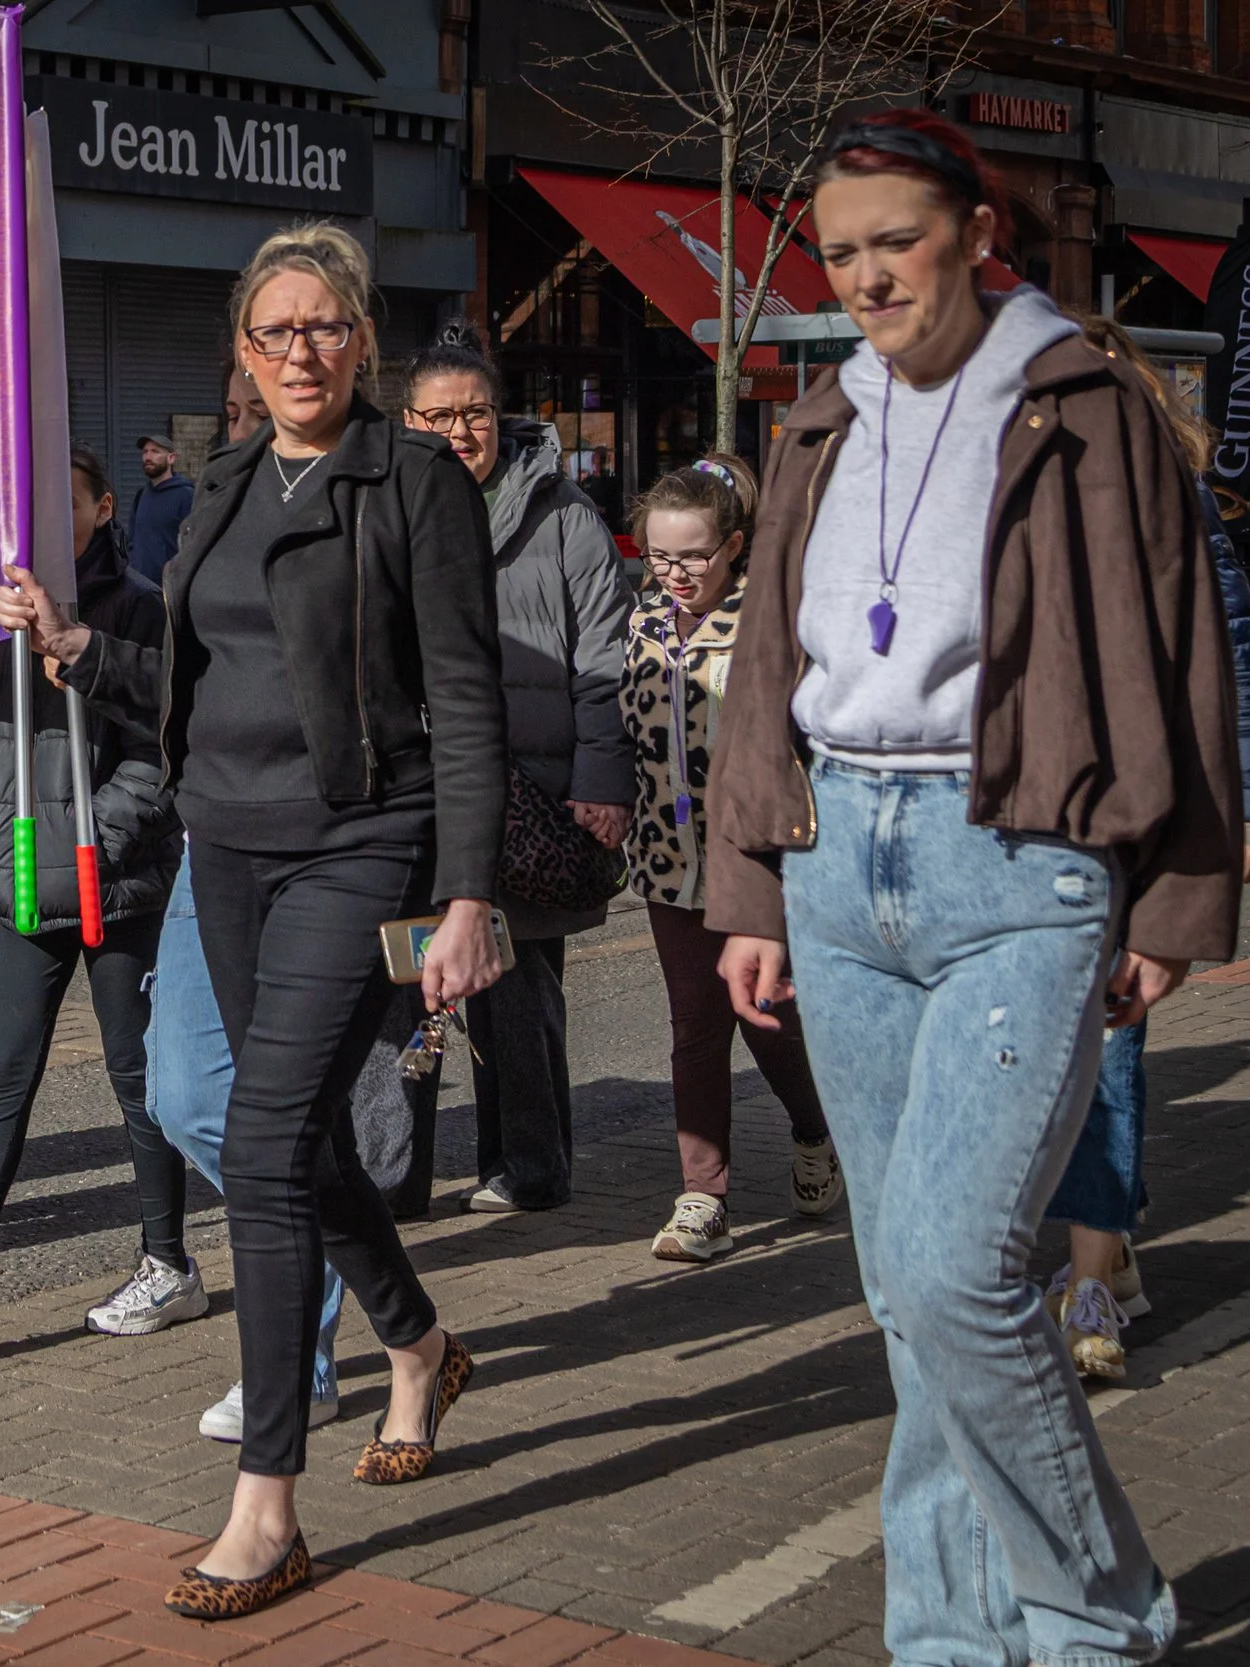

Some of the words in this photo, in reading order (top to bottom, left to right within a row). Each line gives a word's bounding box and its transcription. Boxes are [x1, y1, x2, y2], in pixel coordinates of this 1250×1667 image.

[79, 100, 199, 176] Jean
[214, 115, 346, 191] Millar
[979, 92, 1071, 133] HAYMARKET
[814, 341, 846, 353] BUS
[1214, 263, 1250, 479] GUINN
